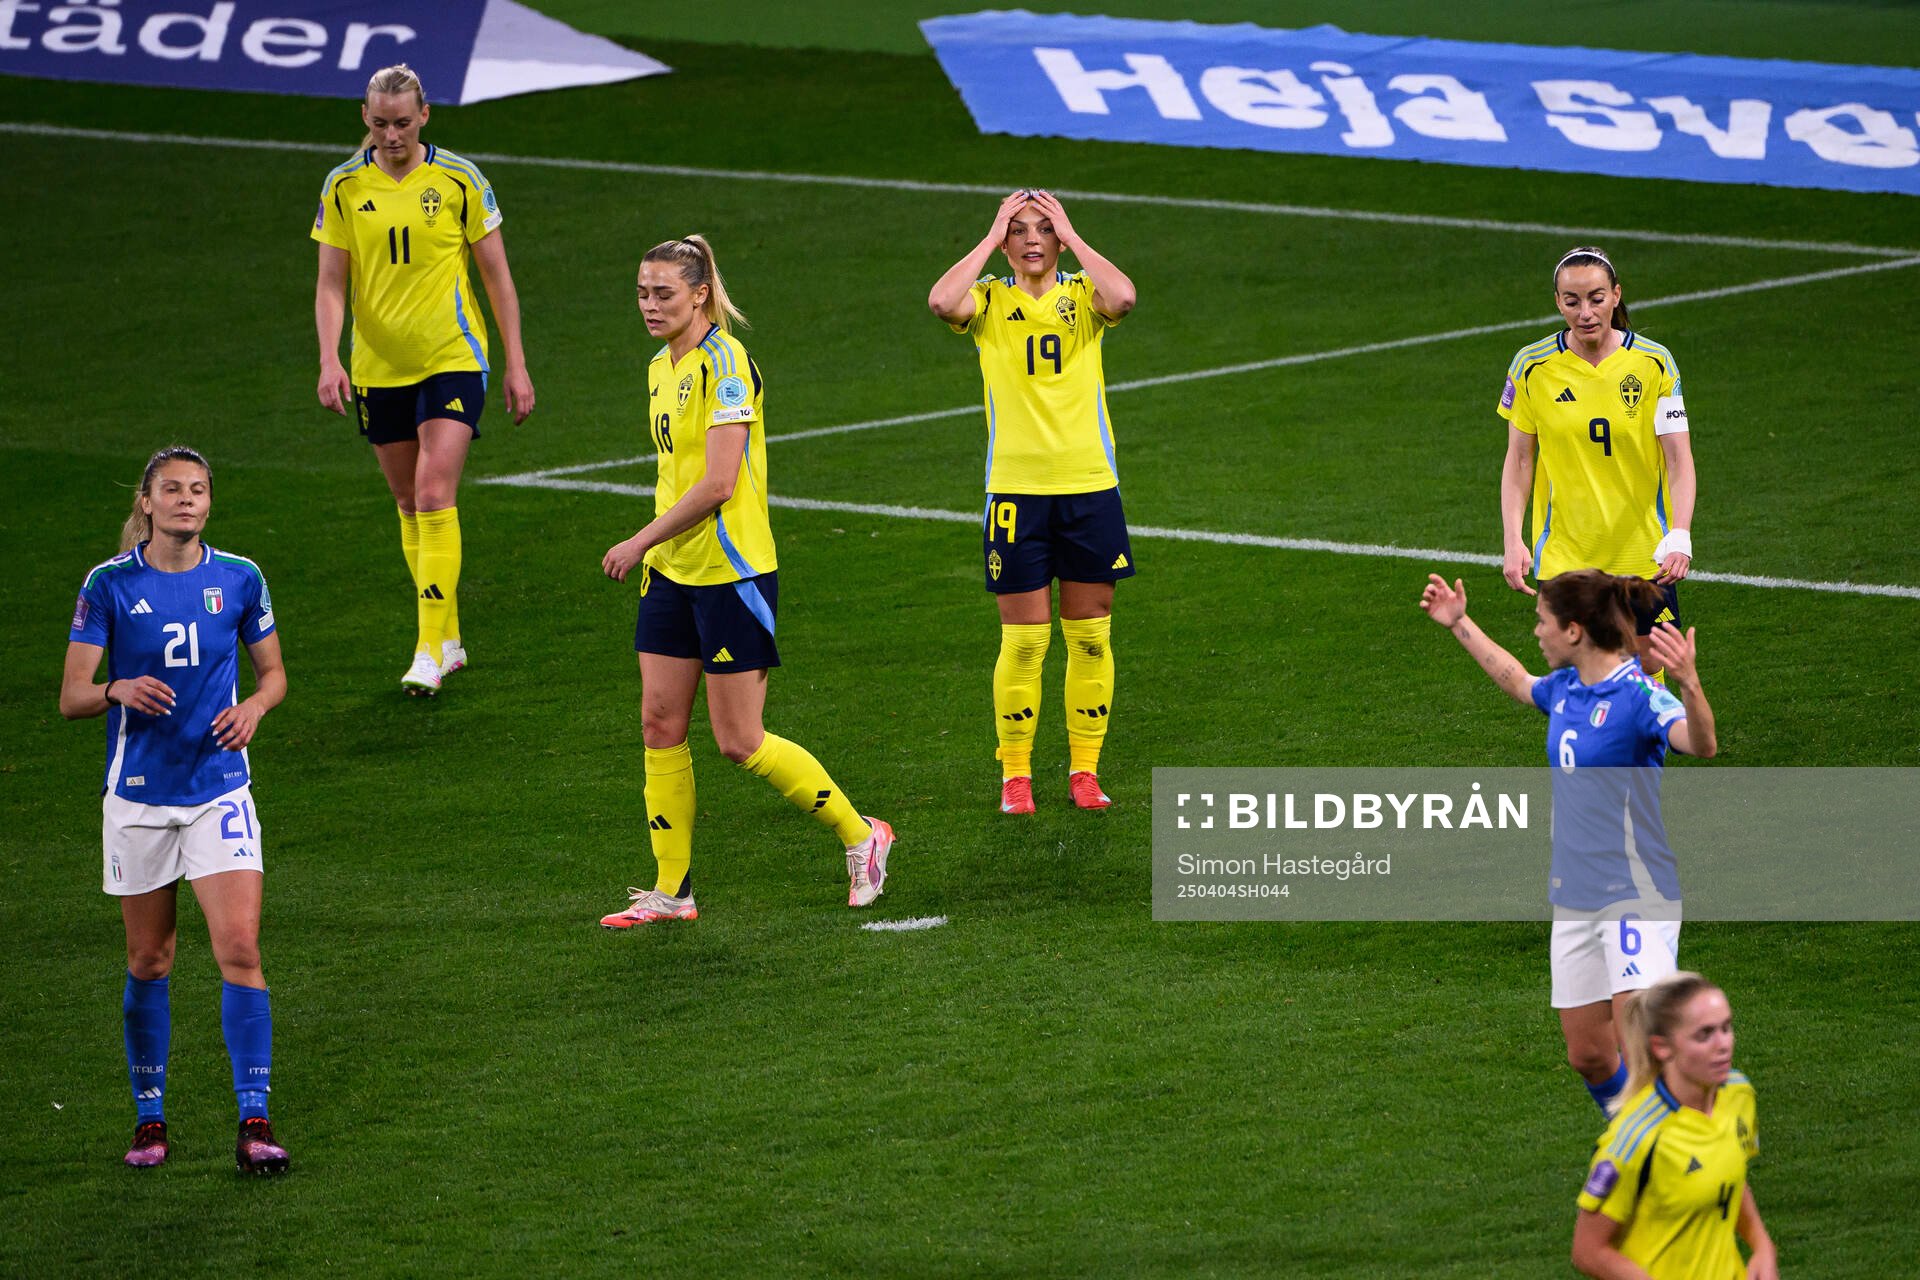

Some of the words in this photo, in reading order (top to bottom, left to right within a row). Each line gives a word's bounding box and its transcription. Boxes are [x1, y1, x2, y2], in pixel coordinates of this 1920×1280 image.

[1033, 47, 1508, 148] Heja
[1530, 79, 1920, 168] Sve
[388, 226, 411, 265] 11
[1026, 333, 1062, 375] 19
[655, 413, 674, 454] 18
[1588, 417, 1612, 457] 9
[989, 500, 1017, 543] 19
[162, 622, 200, 667] 21
[1559, 729, 1578, 774] 6
[218, 800, 254, 840] 21
[1620, 912, 1642, 956] 6
[132, 1065, 164, 1074] ITALIA
[1717, 1182, 1736, 1220] 4
